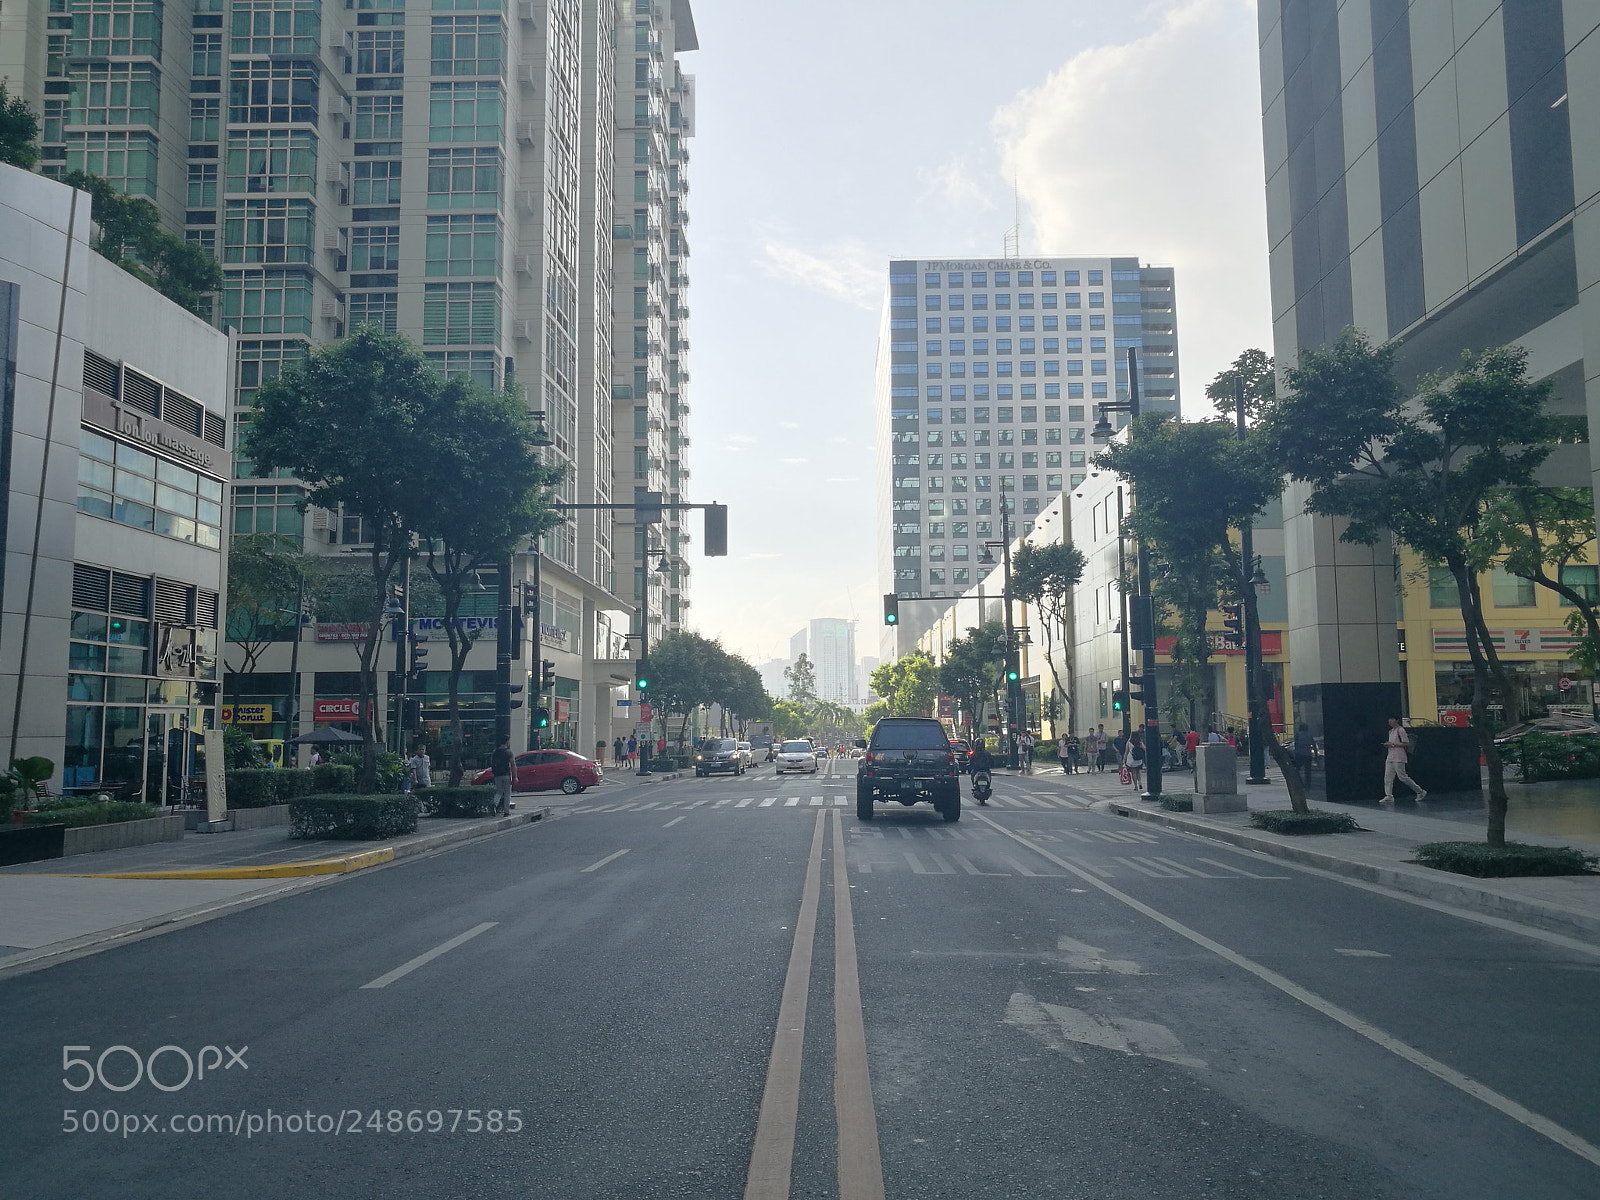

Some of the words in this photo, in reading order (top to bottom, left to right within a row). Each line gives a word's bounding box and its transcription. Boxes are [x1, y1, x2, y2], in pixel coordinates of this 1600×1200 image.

[987, 260, 1021, 270] CHASE
[1023, 260, 1032, 269] &
[159, 433, 213, 466] massage
[319, 704, 350, 713] CIRCLE
